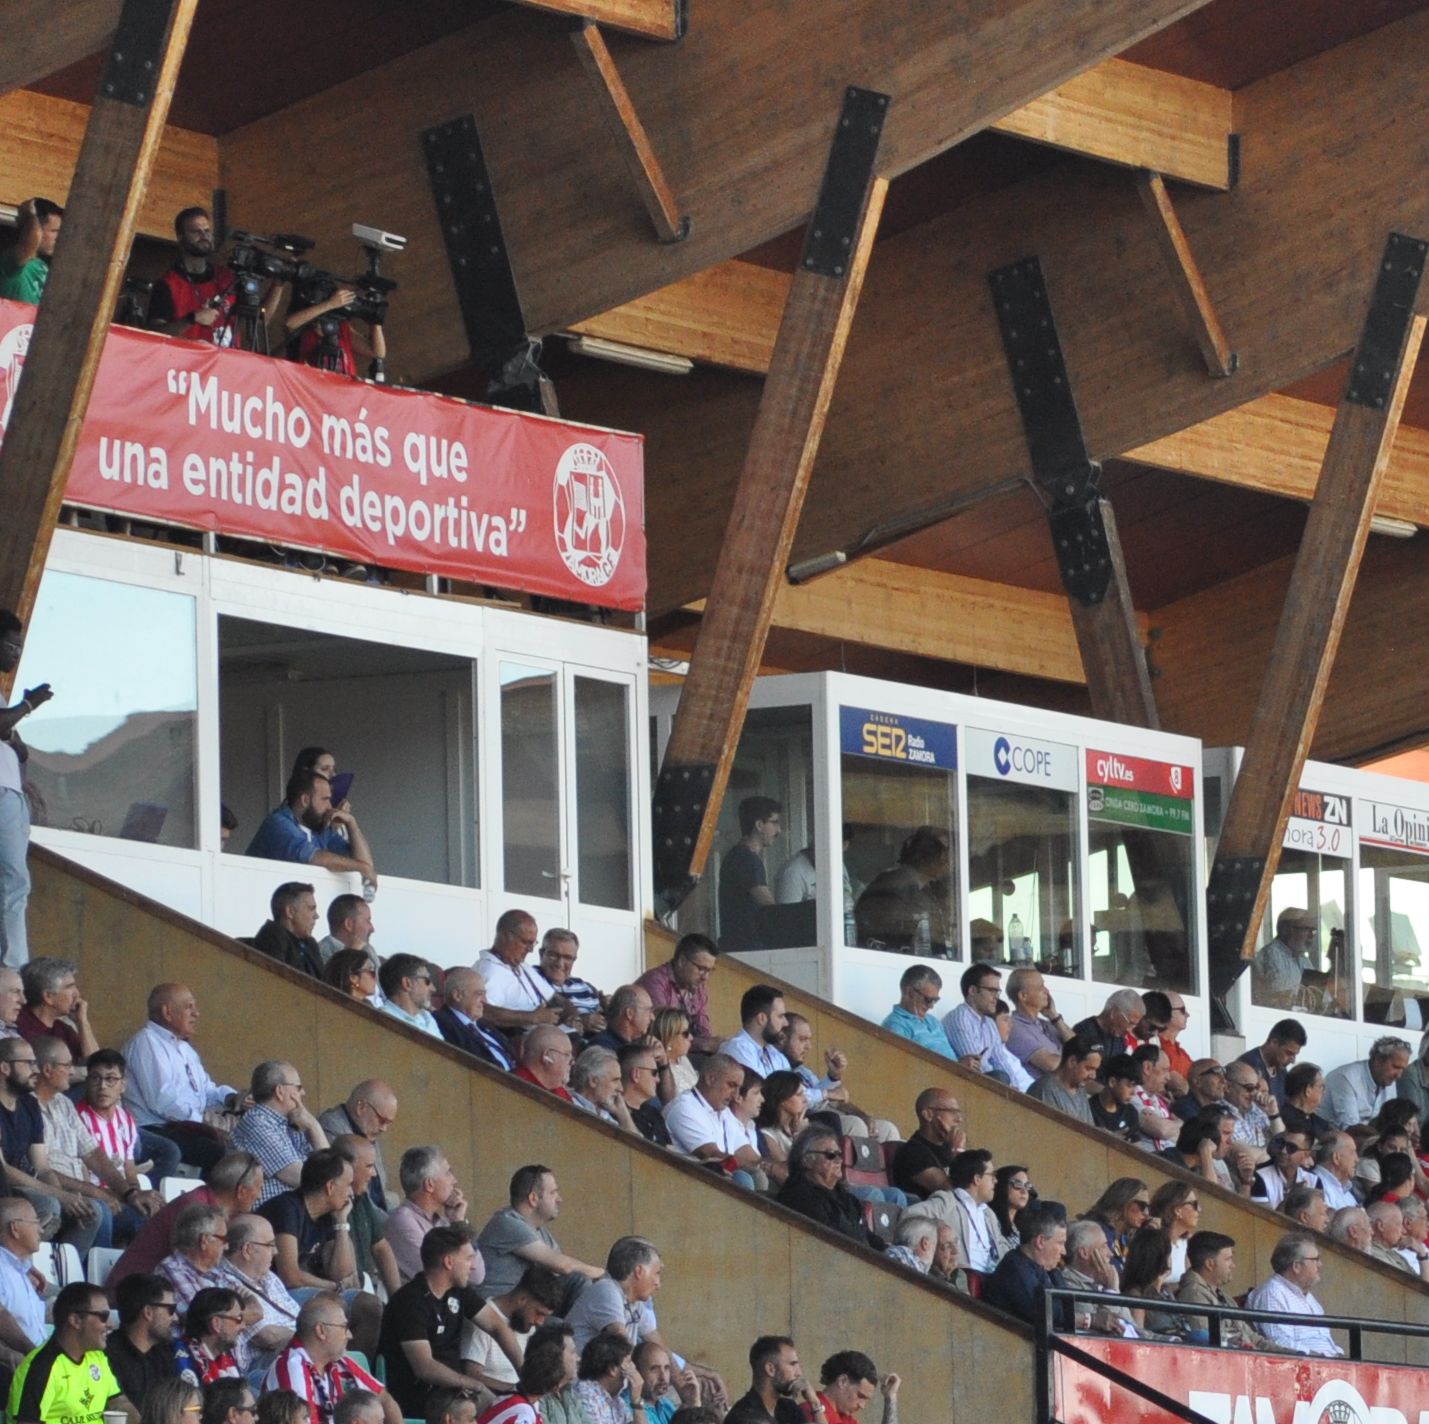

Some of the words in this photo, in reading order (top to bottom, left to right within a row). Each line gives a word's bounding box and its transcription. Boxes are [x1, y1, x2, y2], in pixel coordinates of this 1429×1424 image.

[321, 407, 391, 468] más
[403, 431, 468, 485] que
[99, 436, 168, 490] una
[181, 451, 328, 520] entidad
[339, 474, 526, 557] deportiva”
[862, 722, 907, 760] SER
[908, 748, 936, 764] ZAMORA
[1012, 745, 1051, 777] COPE
[1140, 803, 1164, 816] ZAMORA
[1323, 796, 1348, 825] ZN
[1372, 804, 1389, 835] La
[1316, 825, 1341, 852] 3.0
